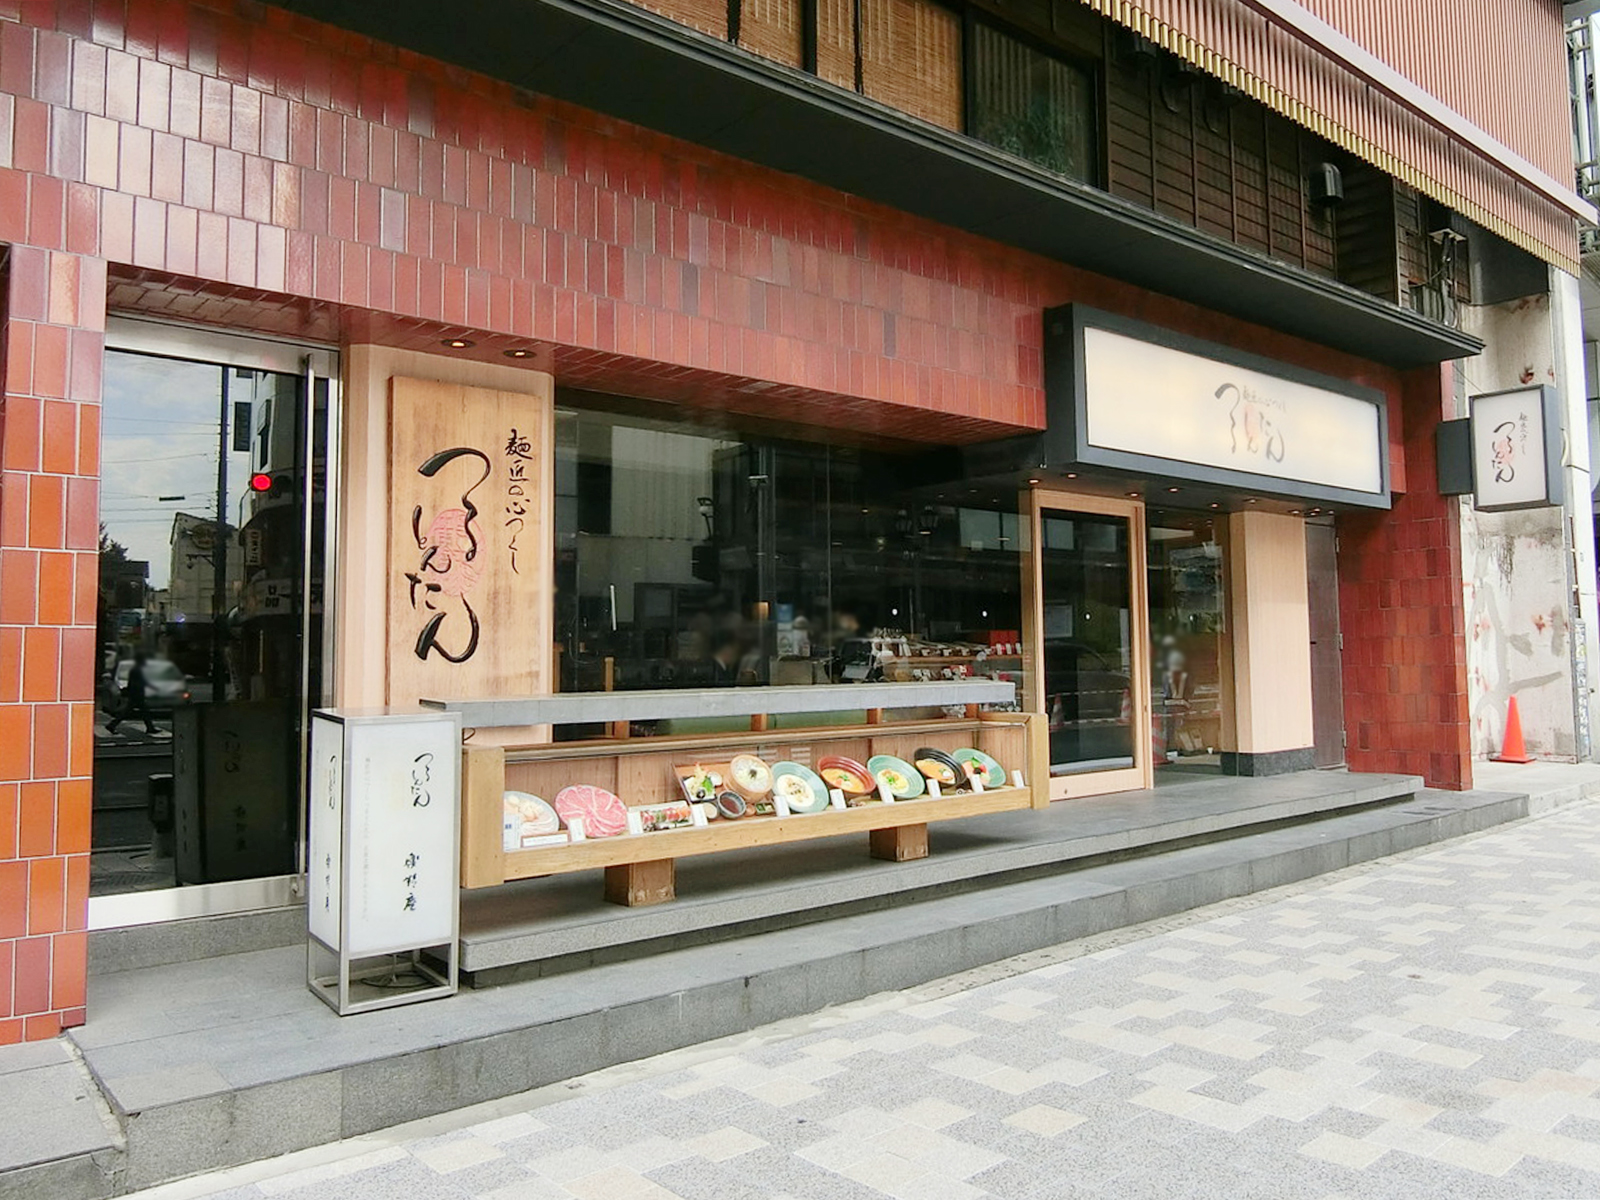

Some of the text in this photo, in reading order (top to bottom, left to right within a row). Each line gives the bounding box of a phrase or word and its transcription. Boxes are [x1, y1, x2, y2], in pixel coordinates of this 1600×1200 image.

[504, 428, 533, 574] 麺匠の心つくし
